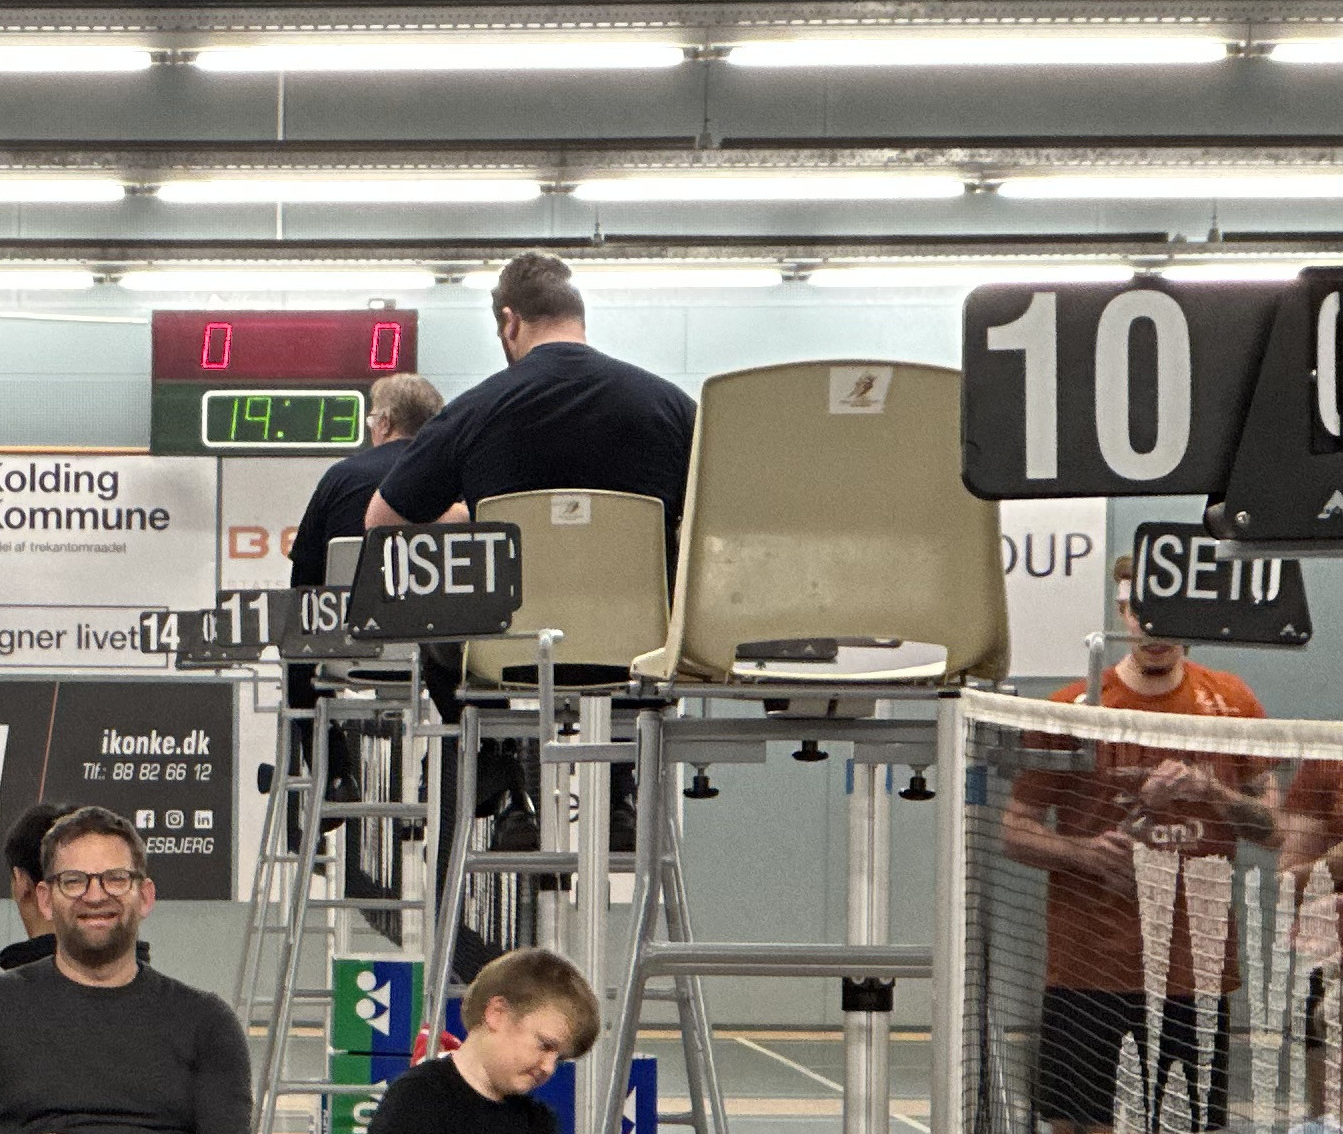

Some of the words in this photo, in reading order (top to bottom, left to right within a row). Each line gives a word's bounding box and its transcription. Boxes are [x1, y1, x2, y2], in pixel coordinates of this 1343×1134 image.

[200, 321, 233, 369] 0
[370, 321, 402, 369] 0
[987, 290, 1192, 481] 10
[230, 396, 358, 442] 19:13
[14, 541, 26, 553] af
[143, 613, 180, 651] 14
[221, 592, 270, 644] 11
[77, 623, 140, 650] livet
[101, 729, 211, 755] ikonke.dk
[112, 762, 135, 780] 88
[139, 763, 161, 781] 82
[165, 763, 187, 781] 66
[194, 763, 213, 781] 12
[145, 837, 215, 854] ESBJERG
